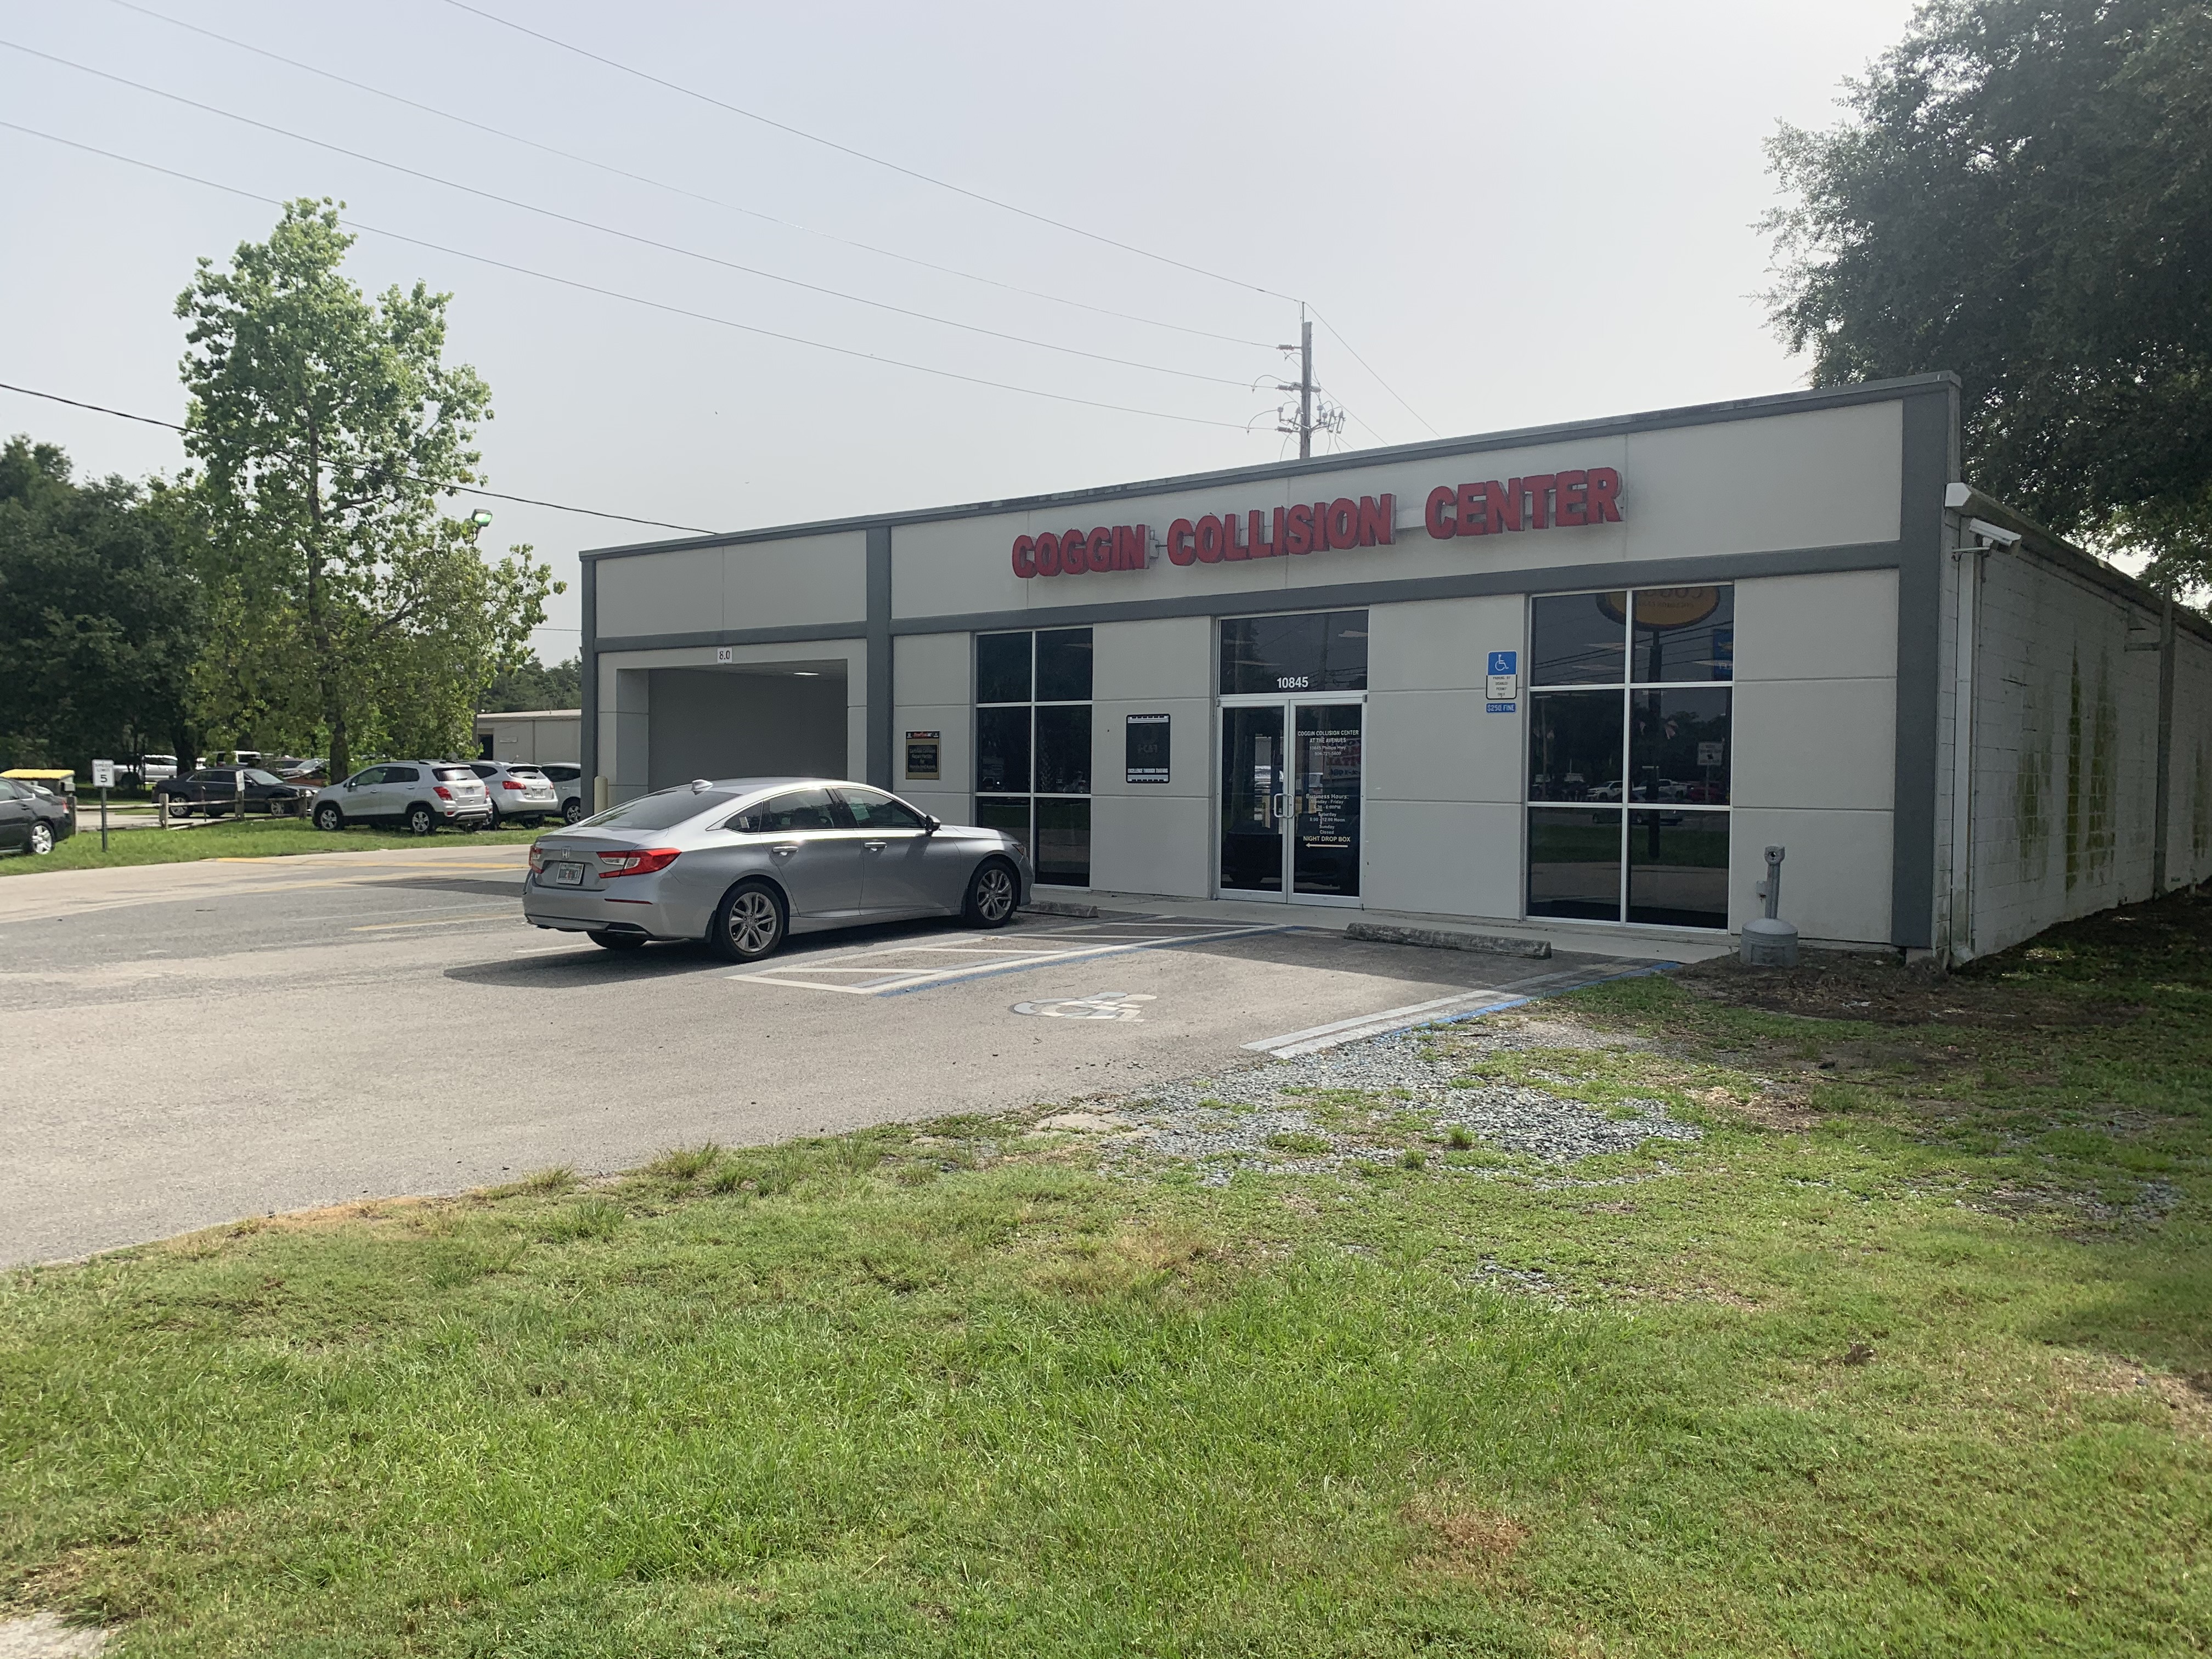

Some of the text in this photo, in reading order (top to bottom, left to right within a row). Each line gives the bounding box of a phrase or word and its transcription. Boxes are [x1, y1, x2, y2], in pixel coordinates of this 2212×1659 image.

[1012, 467, 1624, 578] COGGIN COLLISION CENTER
[719, 650, 730, 659] 8.0
[1277, 676, 1308, 688] 10845
